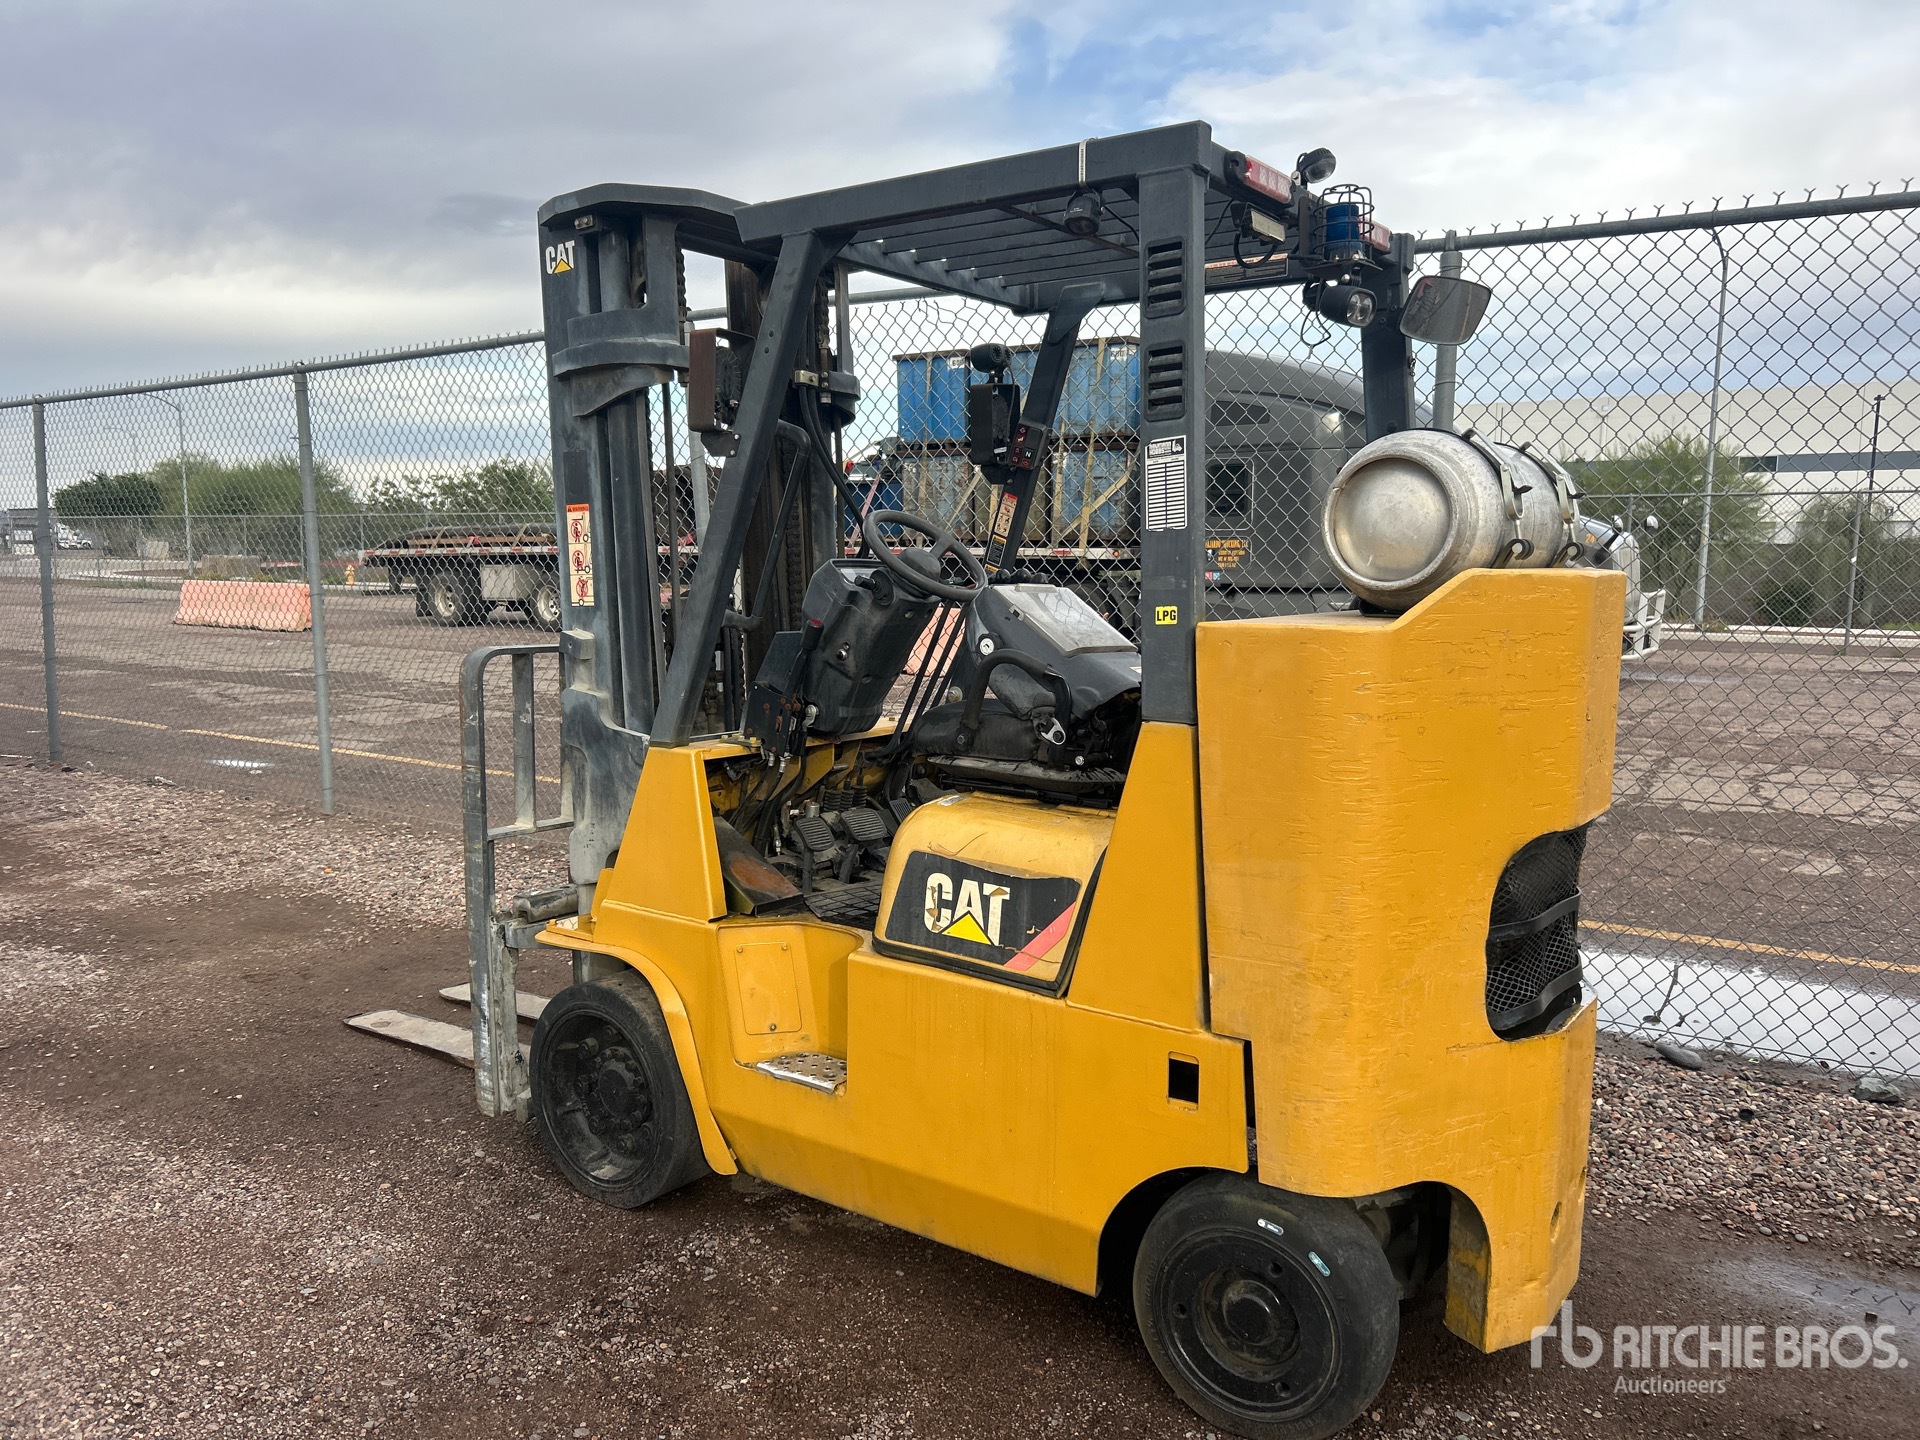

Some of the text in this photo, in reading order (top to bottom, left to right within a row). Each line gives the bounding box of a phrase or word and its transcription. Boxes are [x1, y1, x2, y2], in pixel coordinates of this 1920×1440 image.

[545, 240, 575, 275] CAT
[1156, 609, 1177, 621] LPG
[924, 872, 1010, 946] CAT
